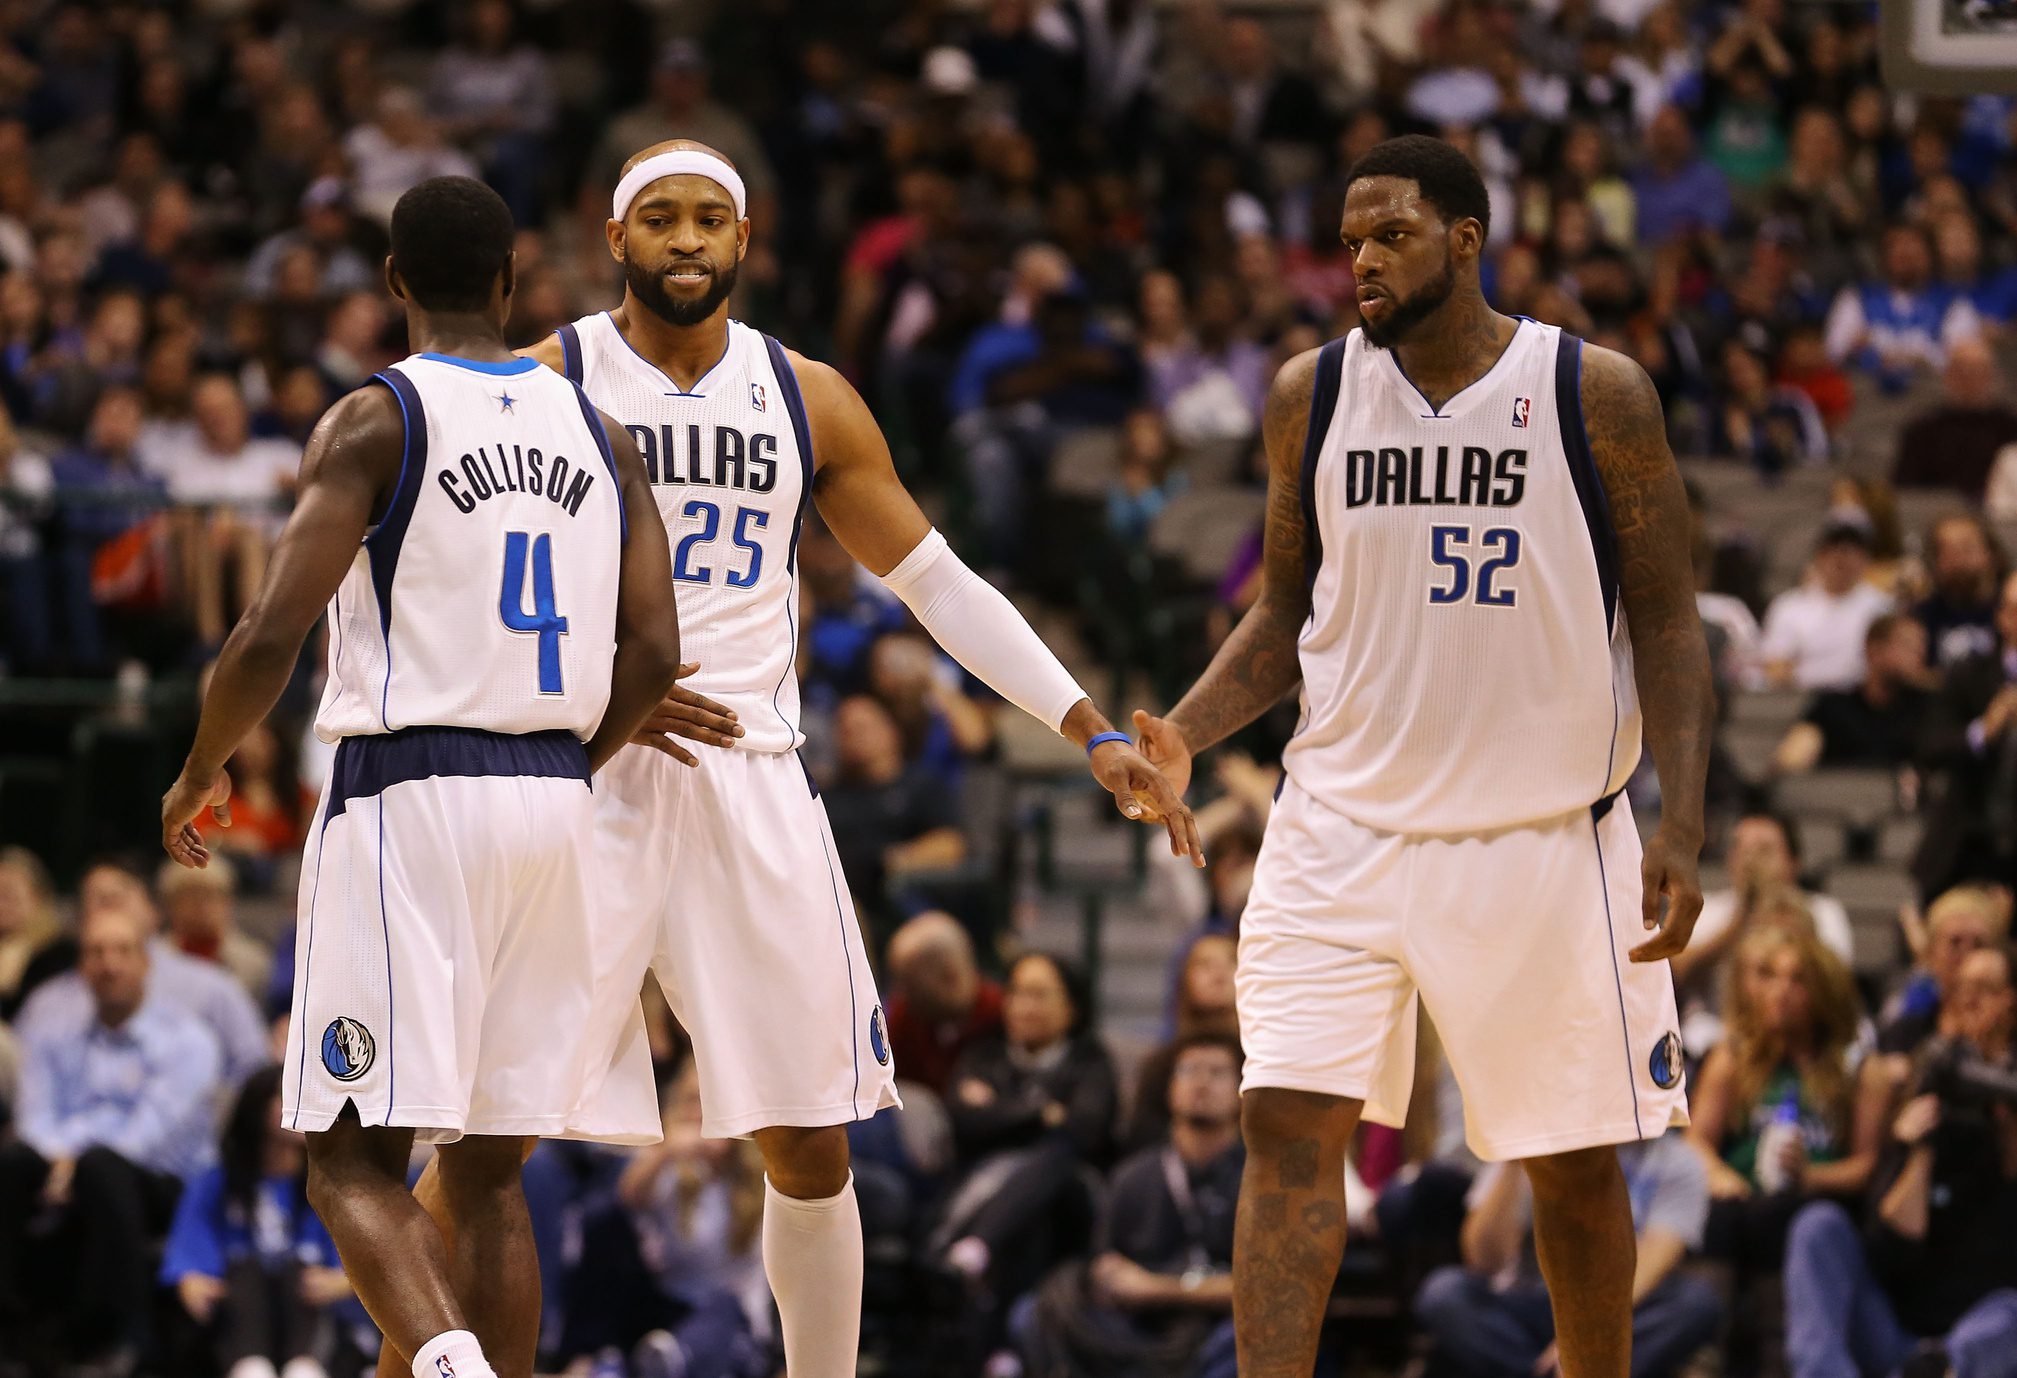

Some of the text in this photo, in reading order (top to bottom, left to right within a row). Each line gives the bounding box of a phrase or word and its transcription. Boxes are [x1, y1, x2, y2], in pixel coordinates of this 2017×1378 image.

[438, 443, 594, 518] COLLISON
[624, 424, 777, 494] ALLAS
[1346, 446, 1528, 510] DALLAS
[672, 500, 770, 589] 25
[1429, 525, 1522, 608] 52
[498, 530, 568, 695] 4
